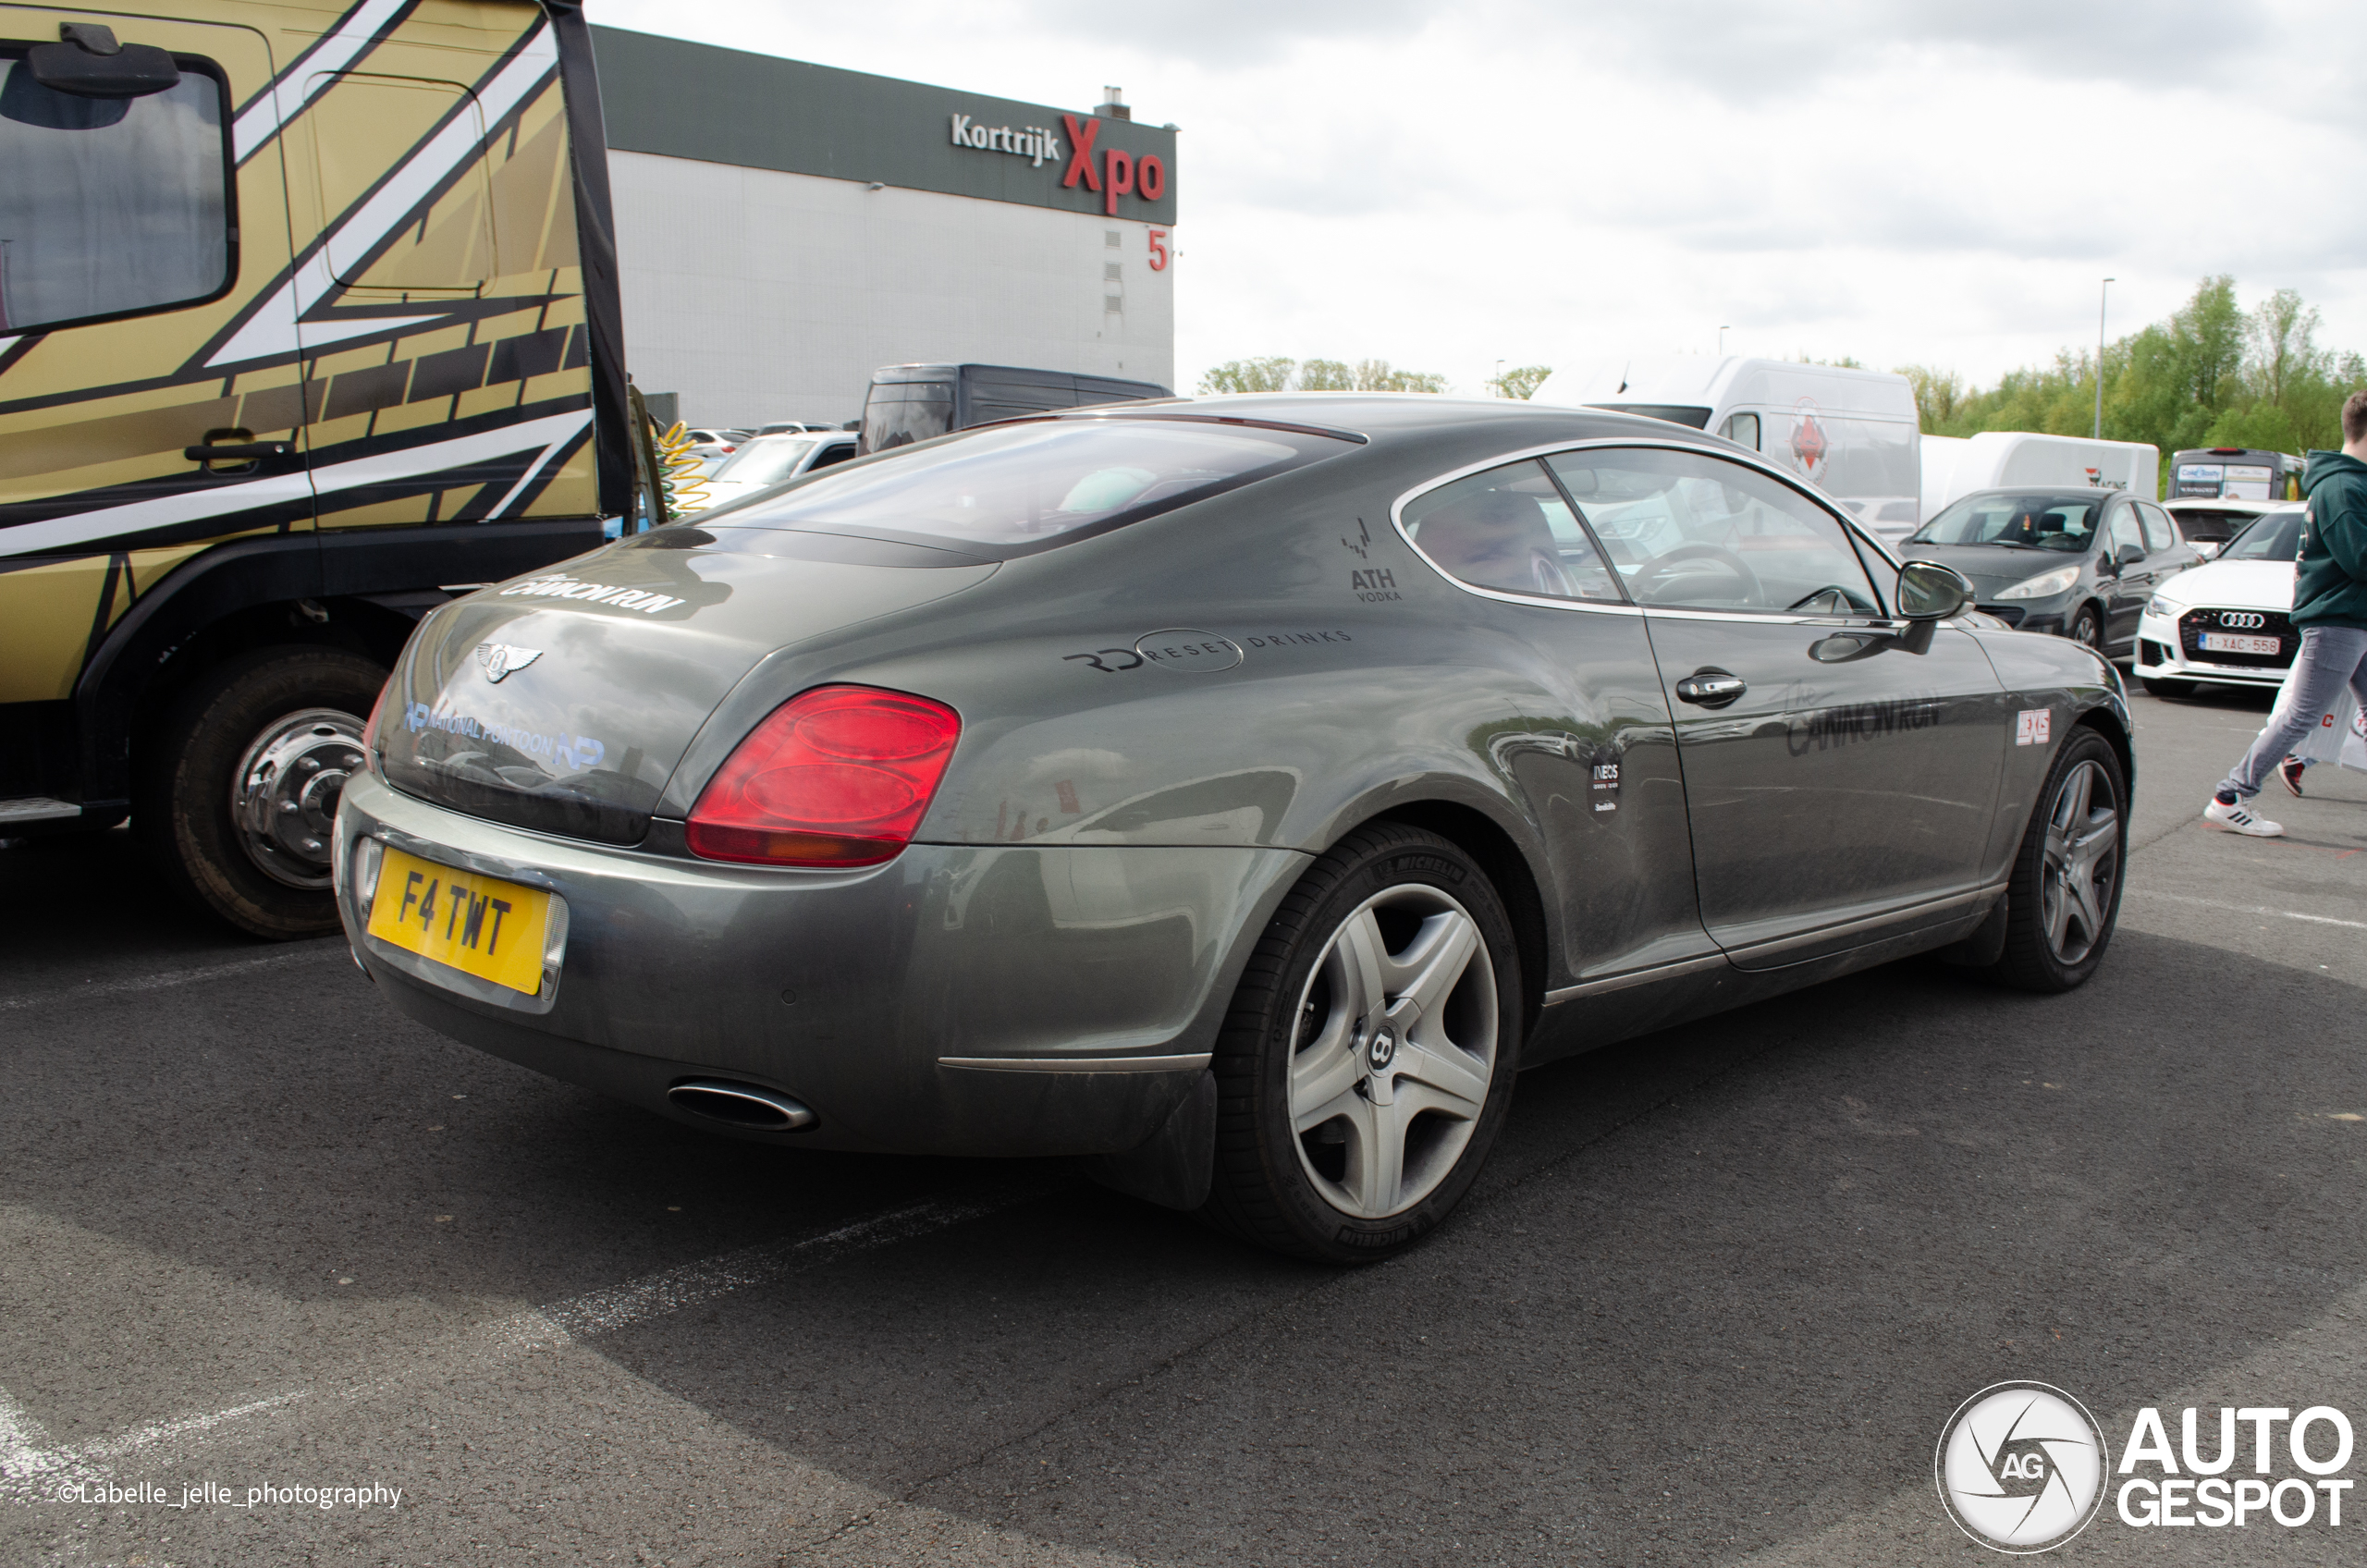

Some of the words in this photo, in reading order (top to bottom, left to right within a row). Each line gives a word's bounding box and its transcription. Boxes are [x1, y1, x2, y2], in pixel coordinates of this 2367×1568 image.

[950, 113, 1061, 167] Kortrijk
[1062, 114, 1165, 214] Xpo
[1149, 229, 1167, 271] 5
[1353, 569, 1396, 590] ATH
[599, 589, 686, 614] RUN
[1356, 592, 1403, 603] VODKA
[1144, 640, 1233, 662] RESET
[1246, 630, 1352, 648] DRINKS
[2208, 636, 2277, 652] 1-XAC-558
[1787, 696, 1896, 757] CANNON
[428, 714, 481, 740] NATIONAL
[481, 722, 554, 756] PONTOON
[553, 731, 606, 770] NP
[1593, 764, 1619, 780] INEOS
[1397, 856, 1465, 881] MICHELIN
[399, 870, 438, 932] F4
[446, 885, 512, 956] TWT
